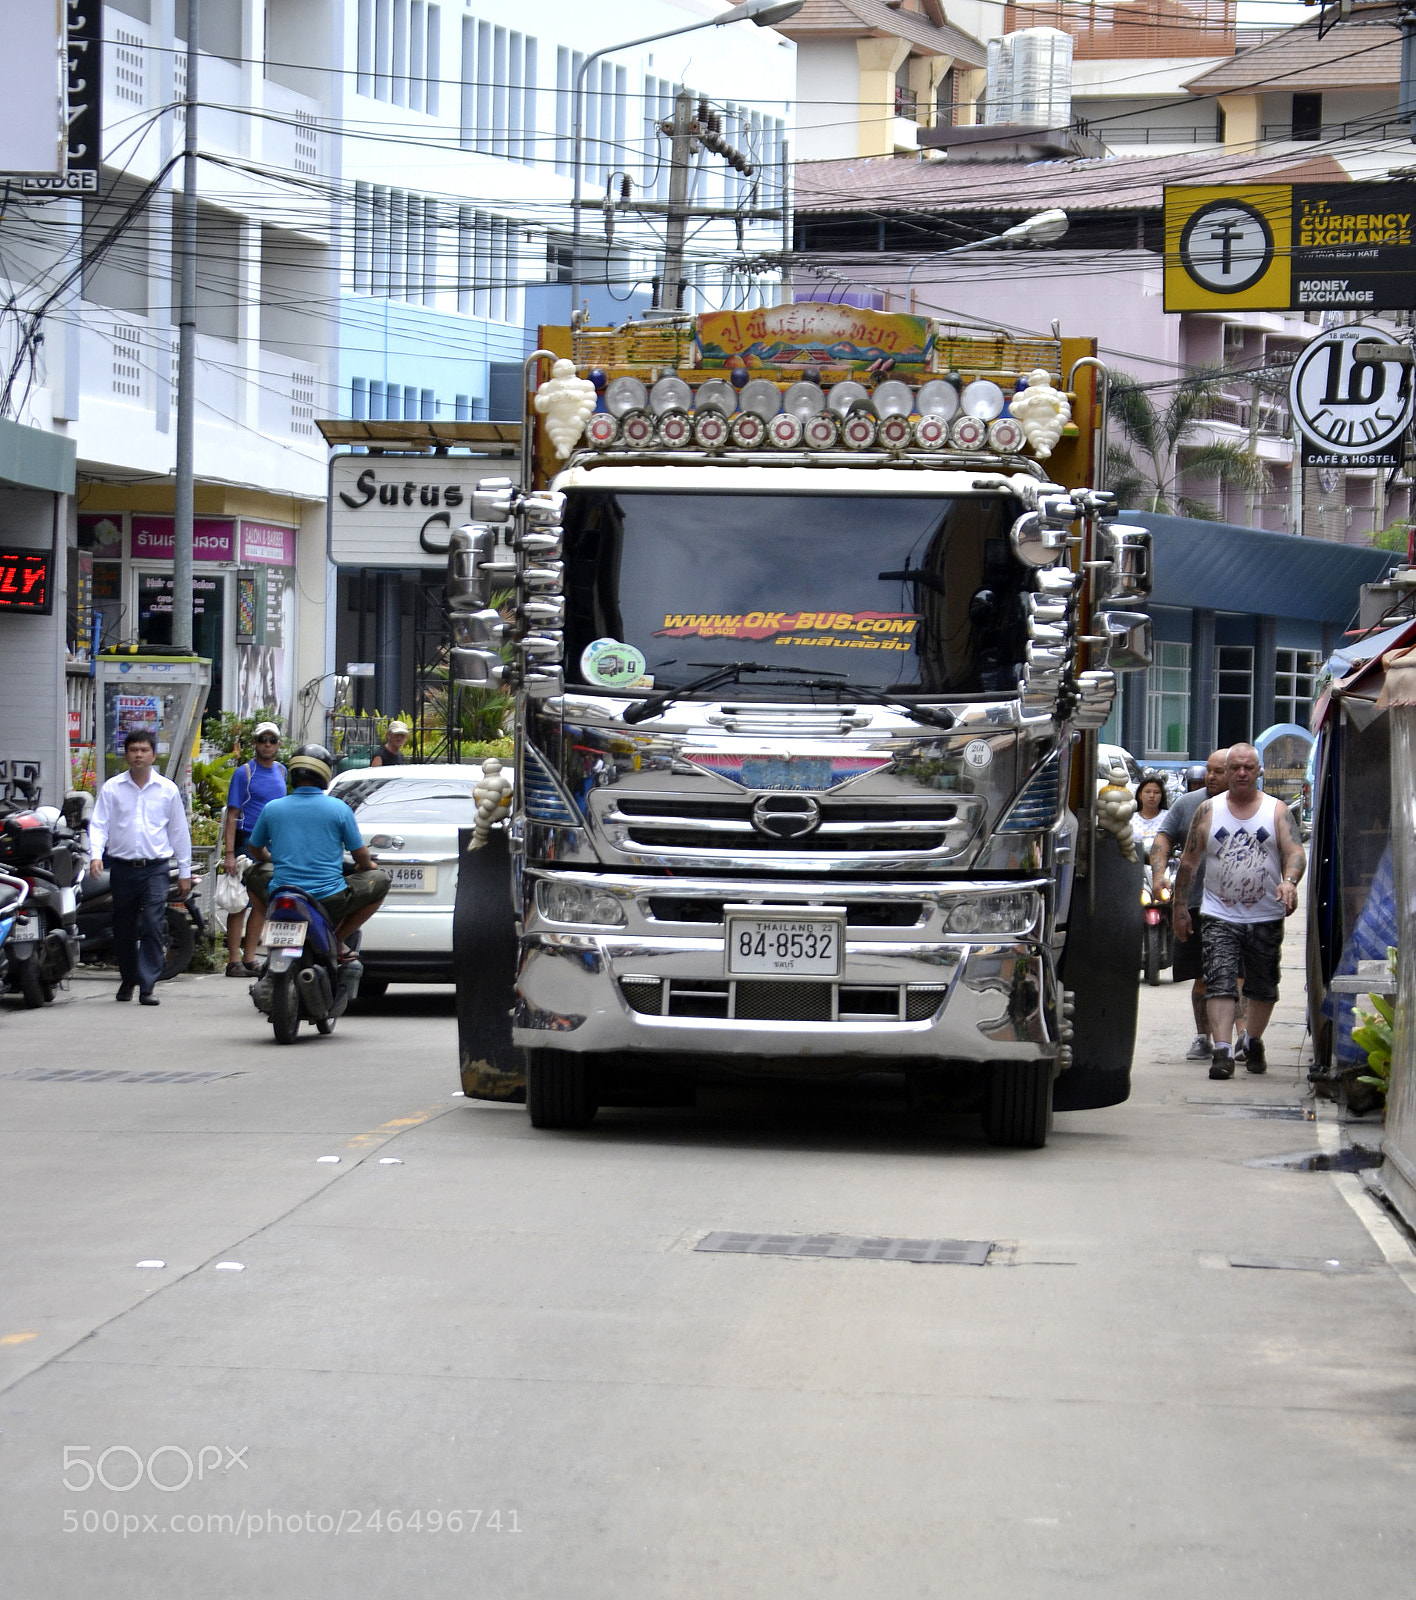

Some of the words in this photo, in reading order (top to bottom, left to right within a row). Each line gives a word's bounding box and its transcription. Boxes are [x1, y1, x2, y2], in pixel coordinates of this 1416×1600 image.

[1301, 213, 1411, 230] CURRENCY
[1301, 230, 1412, 246] EXCHANGE
[1299, 280, 1349, 291] MONEY
[1299, 291, 1374, 302] EXCHANGE
[1308, 452, 1338, 464] CAFÉ
[1341, 455, 1349, 463] &
[1351, 455, 1397, 464] HOSTEL
[339, 469, 464, 509] Sutus
[0, 566, 45, 594] LY
[396, 868, 423, 880] 4866
[756, 923, 813, 932] THAILAND
[740, 931, 832, 959] 84-8532
